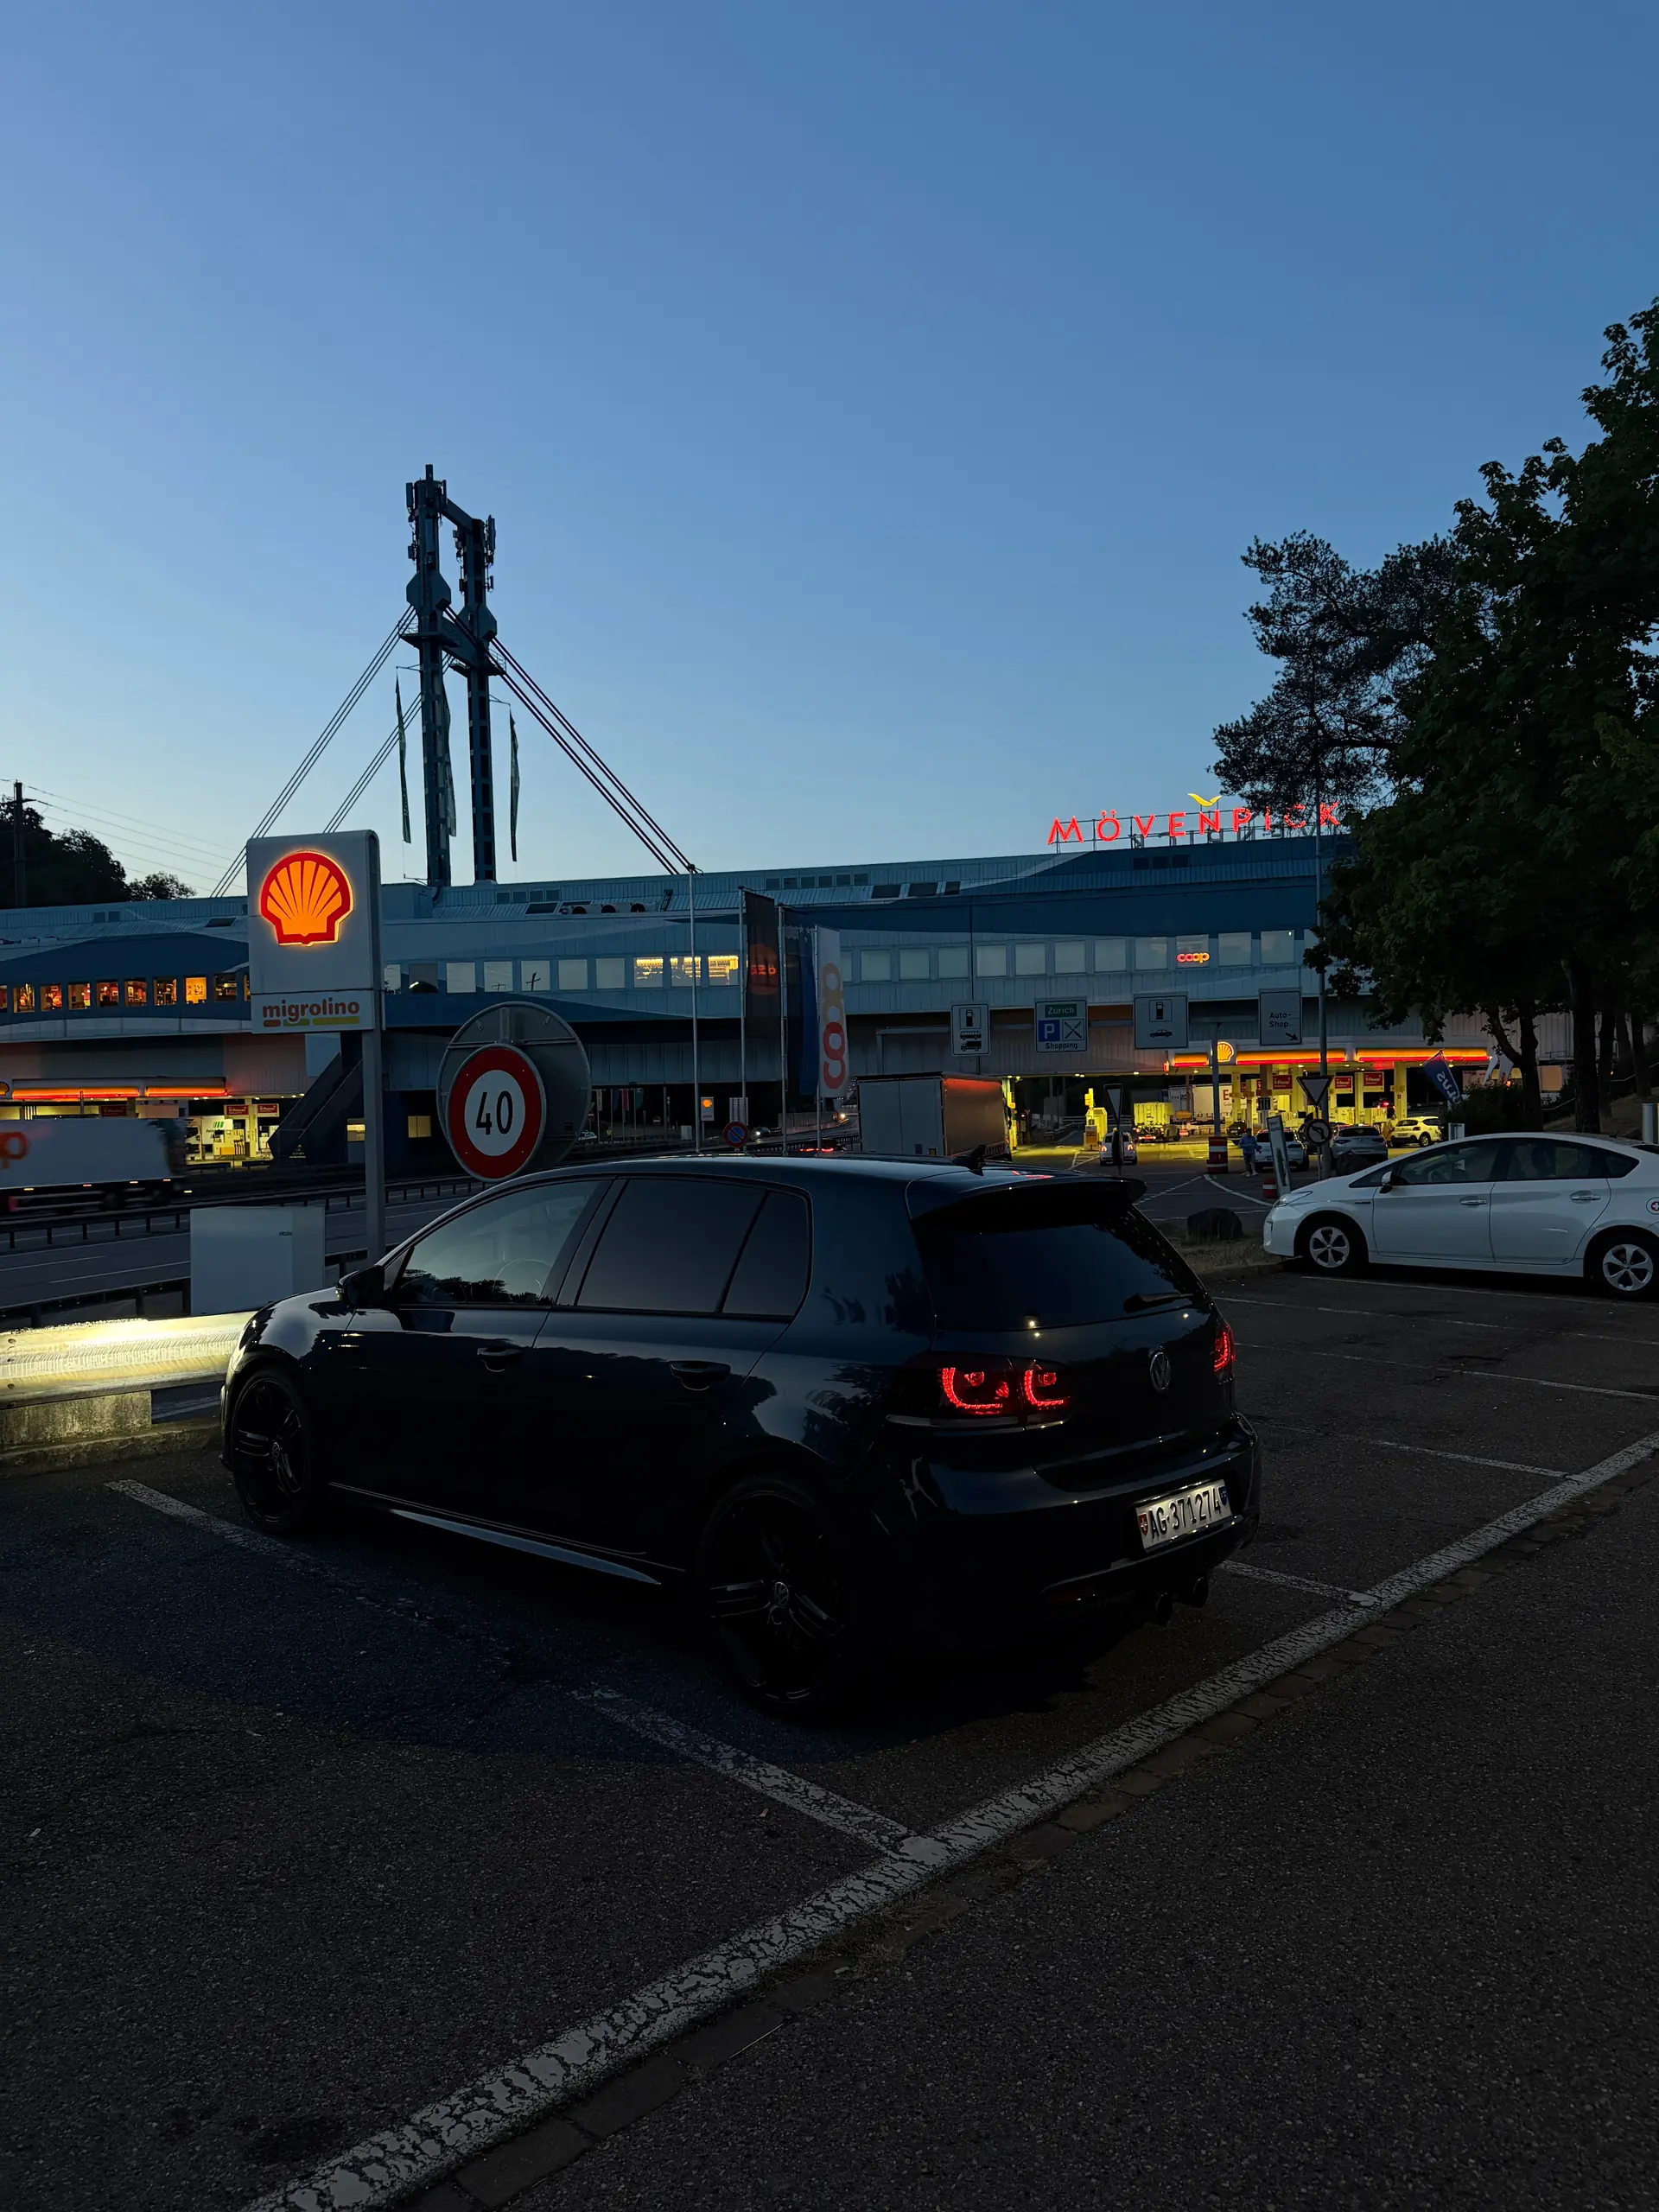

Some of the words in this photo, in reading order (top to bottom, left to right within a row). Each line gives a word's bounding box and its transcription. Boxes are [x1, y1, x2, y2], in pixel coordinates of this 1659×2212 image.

[1047, 800, 1341, 845] MÖVENPICK
[1176, 952, 1210, 963] coop
[262, 997, 360, 1022] migrolino
[1044, 1023, 1055, 1039] P
[1269, 1020, 1289, 1029] Shop
[476, 1090, 513, 1135] 40
